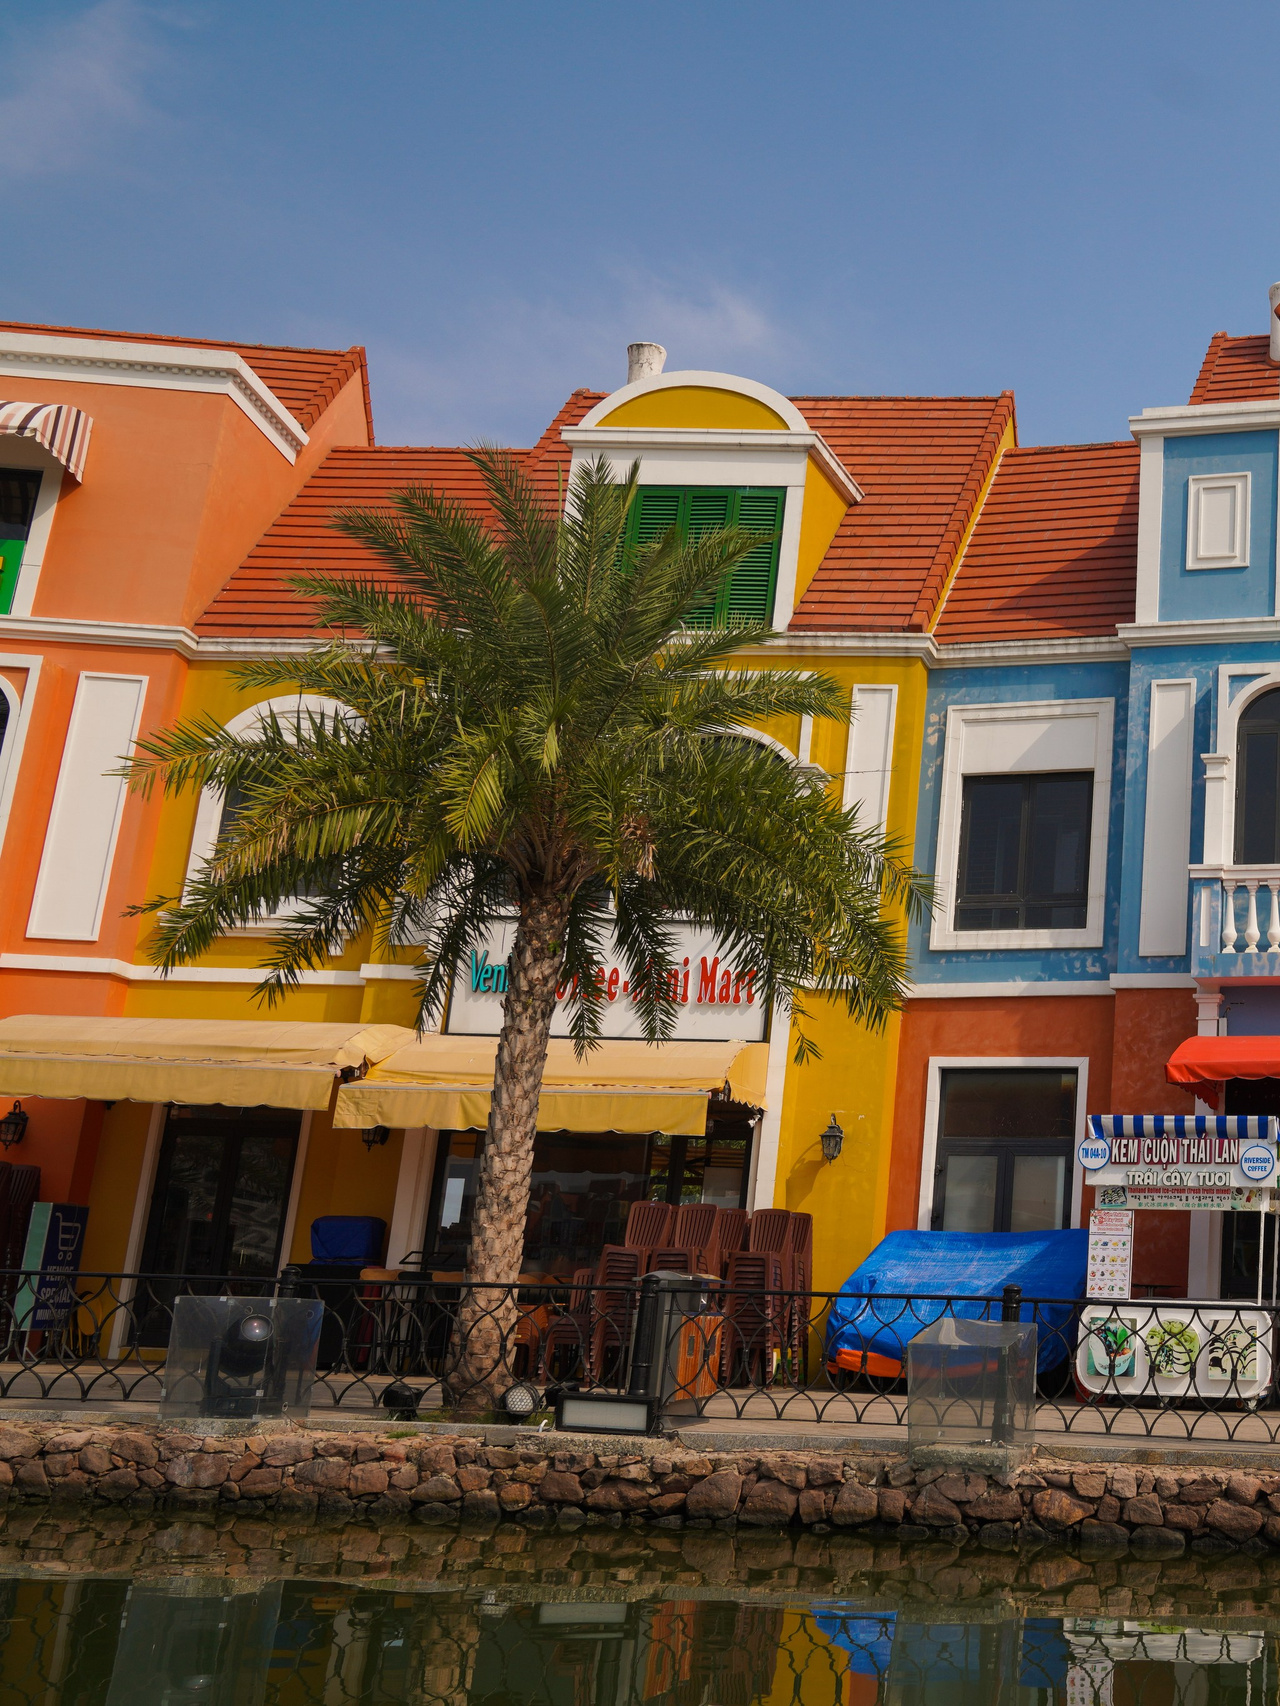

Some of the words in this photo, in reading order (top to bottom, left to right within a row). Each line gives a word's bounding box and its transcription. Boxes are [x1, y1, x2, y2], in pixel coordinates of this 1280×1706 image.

[697, 956, 757, 1004] Mart
[1111, 1139, 1138, 1163] KEM
[1144, 1134, 1178, 1169] CUỘN
[1182, 1136, 1210, 1163] THÁI
[1215, 1138, 1240, 1163] LAN
[1243, 1157, 1271, 1165] RIVERSIDE
[1247, 1165, 1268, 1173] COFFEE
[1127, 1168, 1158, 1186] TRÁI
[1162, 1168, 1191, 1186] CÂY
